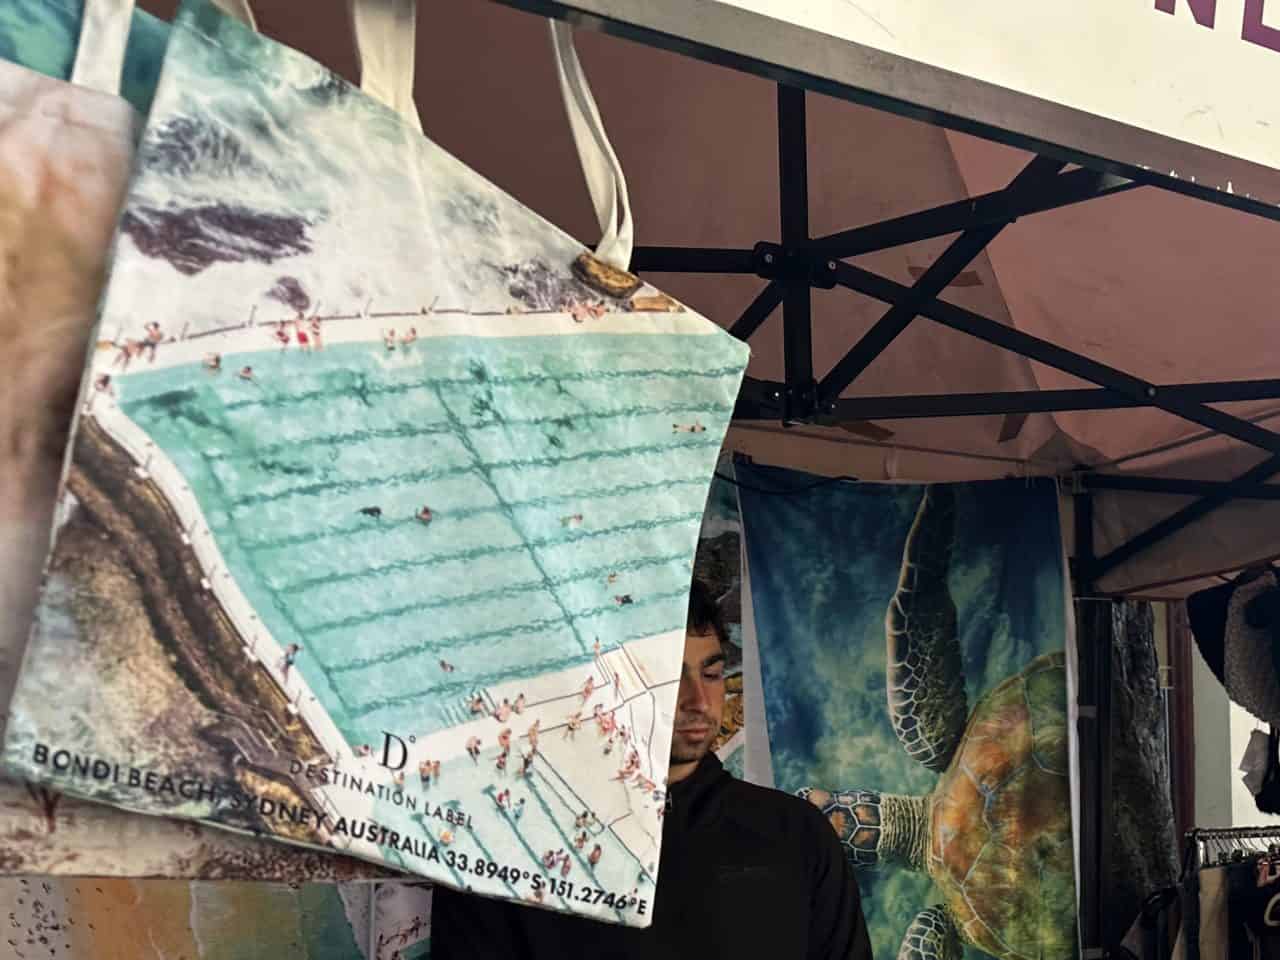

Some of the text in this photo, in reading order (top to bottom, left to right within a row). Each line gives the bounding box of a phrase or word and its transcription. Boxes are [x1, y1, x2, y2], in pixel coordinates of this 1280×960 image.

[33, 743, 119, 783] BONDI
[231, 791, 328, 829] SYDNEY
[333, 816, 440, 863] AUSTRALIA
[549, 878, 647, 916] 151.2746°E
[289, 759, 473, 831] DESTINATION LABEL
